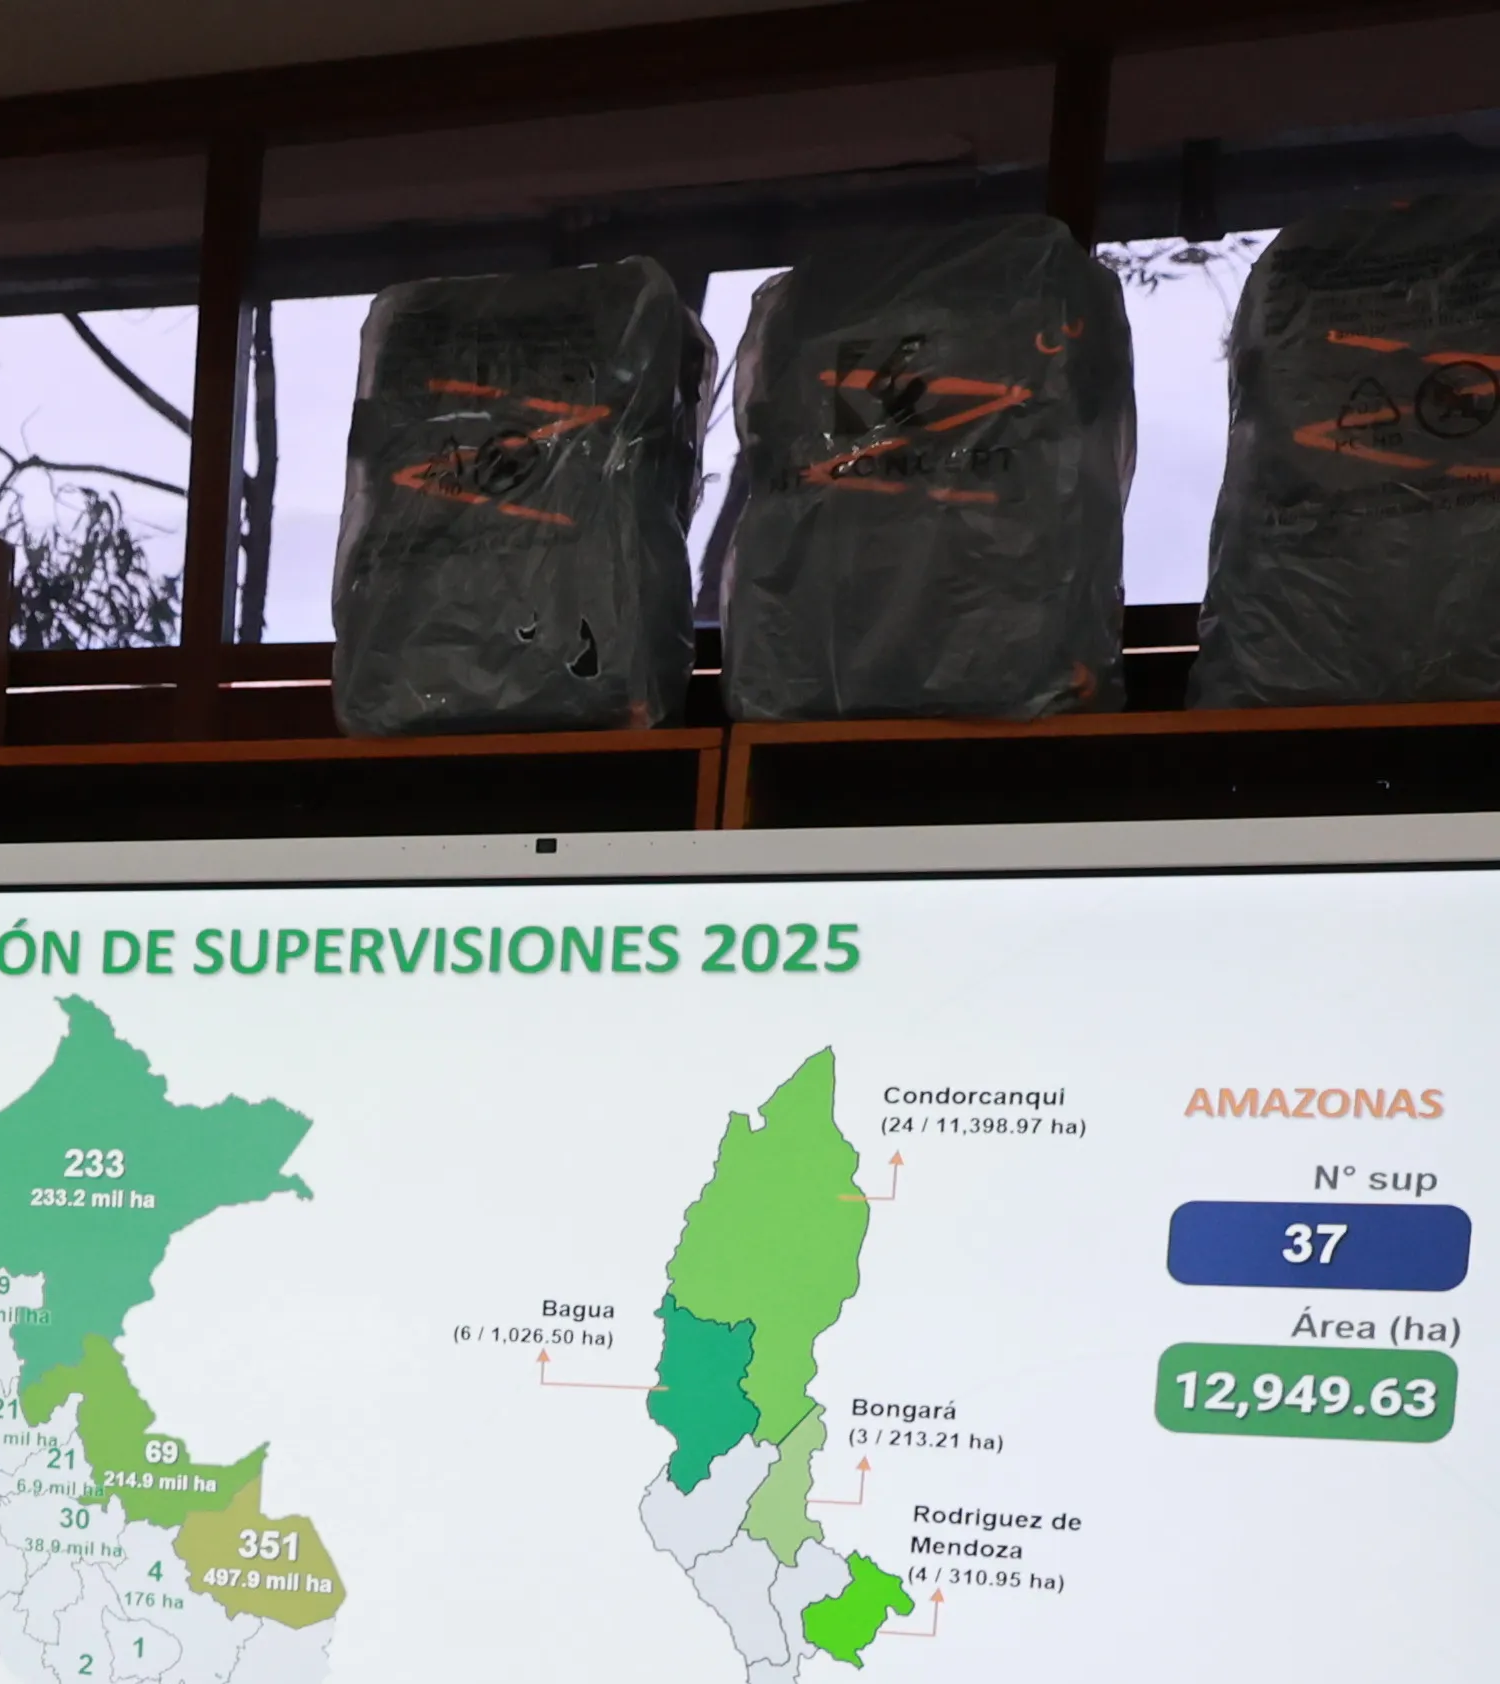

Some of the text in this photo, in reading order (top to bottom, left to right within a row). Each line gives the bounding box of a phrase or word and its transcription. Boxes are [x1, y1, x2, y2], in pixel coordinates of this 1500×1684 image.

[102, 929, 175, 976] DE
[193, 923, 681, 977] SUPERVISIONES
[702, 922, 862, 975] 2025
[883, 1086, 1066, 1110] Condorcanqui
[1183, 1087, 1445, 1120] AMAZONAS
[881, 1117, 1087, 1139] (24 11,398.97 ha)
[63, 1148, 127, 1179] 233
[1368, 1171, 1439, 1198] sup
[30, 1188, 156, 1209] 233.2 mil ha
[1282, 1222, 1348, 1264] 37
[542, 1300, 616, 1323] Bagua
[453, 1325, 614, 1350] (6 1,026.50 ha)
[1291, 1305, 1462, 1348] Área (ha)
[1175, 1370, 1438, 1420] 12,949.63
[851, 1398, 957, 1423] Bongará
[3, 1430, 31, 1447] mil
[36, 1431, 58, 1448] ha
[848, 1428, 1004, 1454] (3 213.21 ha)
[47, 1447, 76, 1470] 21
[144, 1439, 180, 1465] 69
[103, 1470, 218, 1493] 214.9 mil ha
[60, 1507, 90, 1529] 30
[913, 1505, 1082, 1531] Rodriguez de
[24, 1537, 123, 1558] 38.9 mil ha
[238, 1529, 300, 1561] 351
[910, 1536, 1023, 1560] Mendoza
[147, 1560, 164, 1581] 4
[203, 1567, 333, 1594] 497.9 mil ha
[907, 1565, 1065, 1594] (4 310.95 ha)
[124, 1592, 184, 1609] 176 ha
[132, 1637, 146, 1659] 1
[78, 1654, 94, 1676] 2
